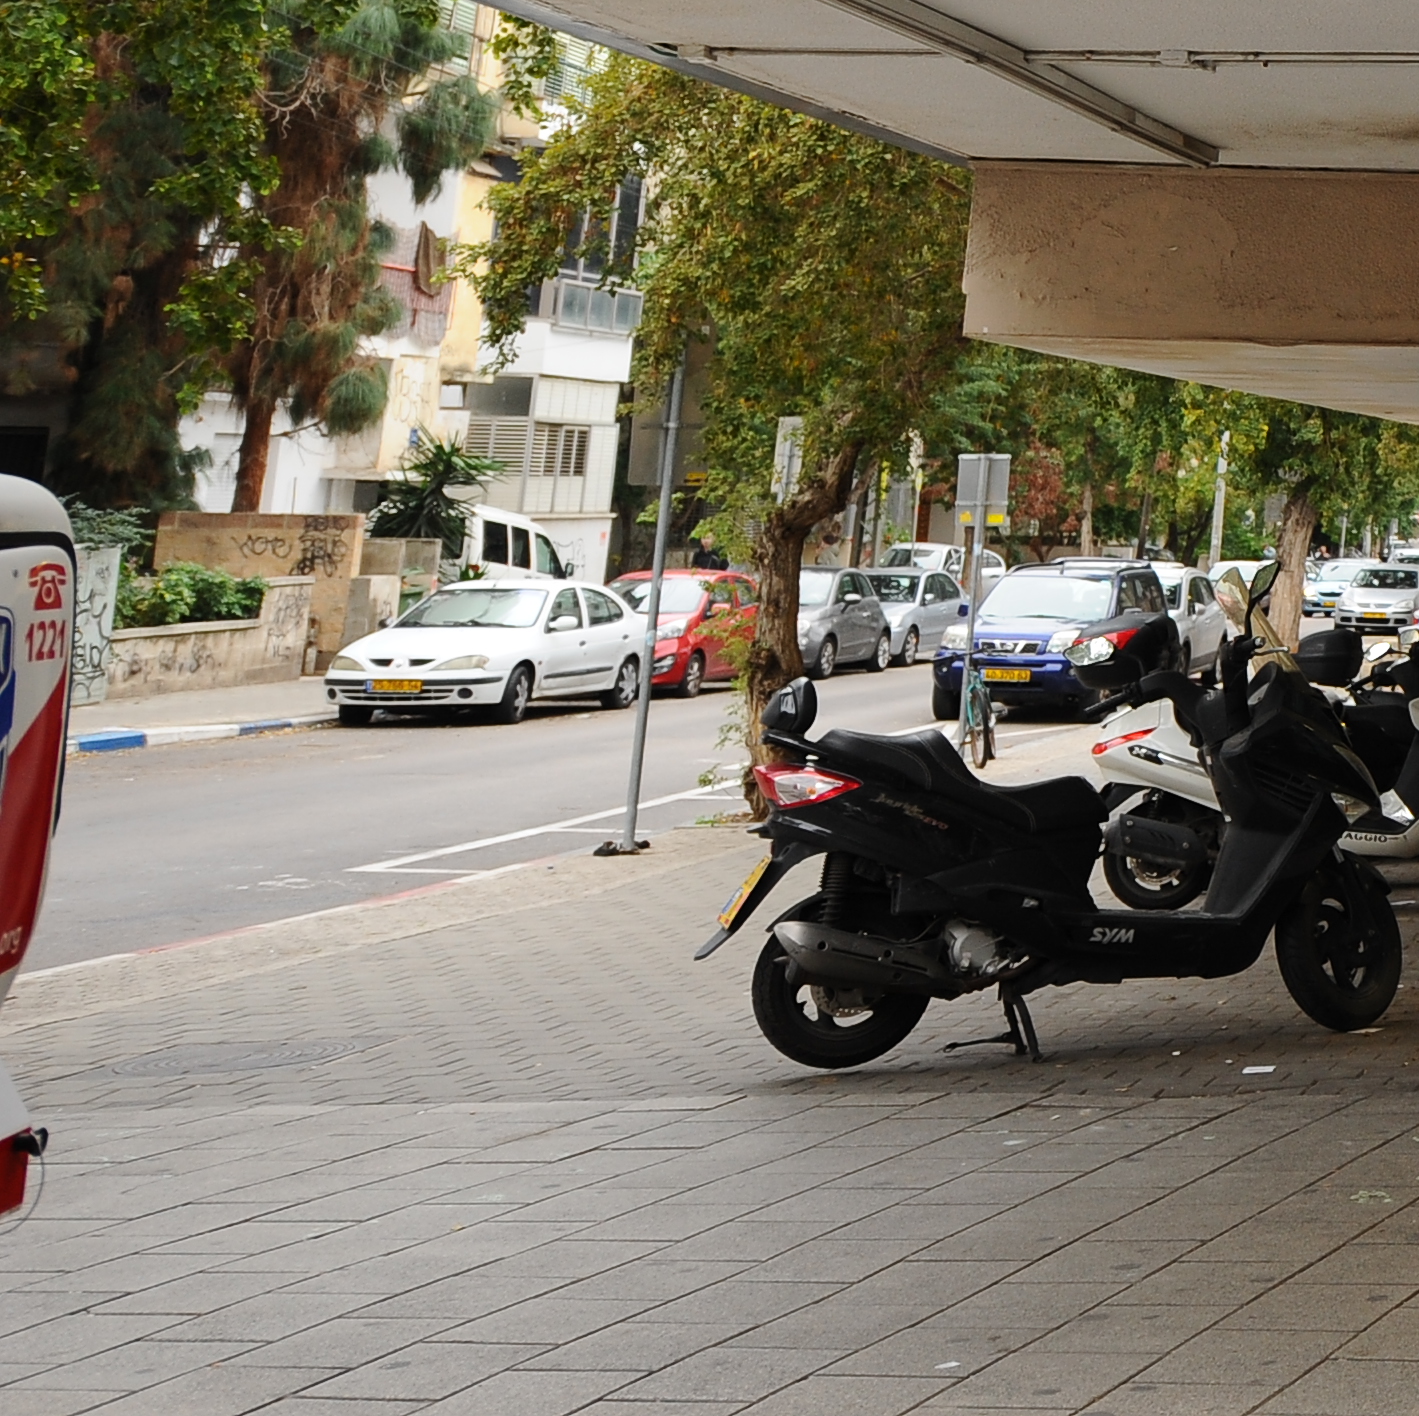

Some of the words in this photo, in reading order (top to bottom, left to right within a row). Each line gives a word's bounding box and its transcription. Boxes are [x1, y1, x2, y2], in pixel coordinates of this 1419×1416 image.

[25, 620, 66, 662] 1221
[1343, 832, 1387, 843] AGGIO
[1089, 927, 1135, 944] SYM
